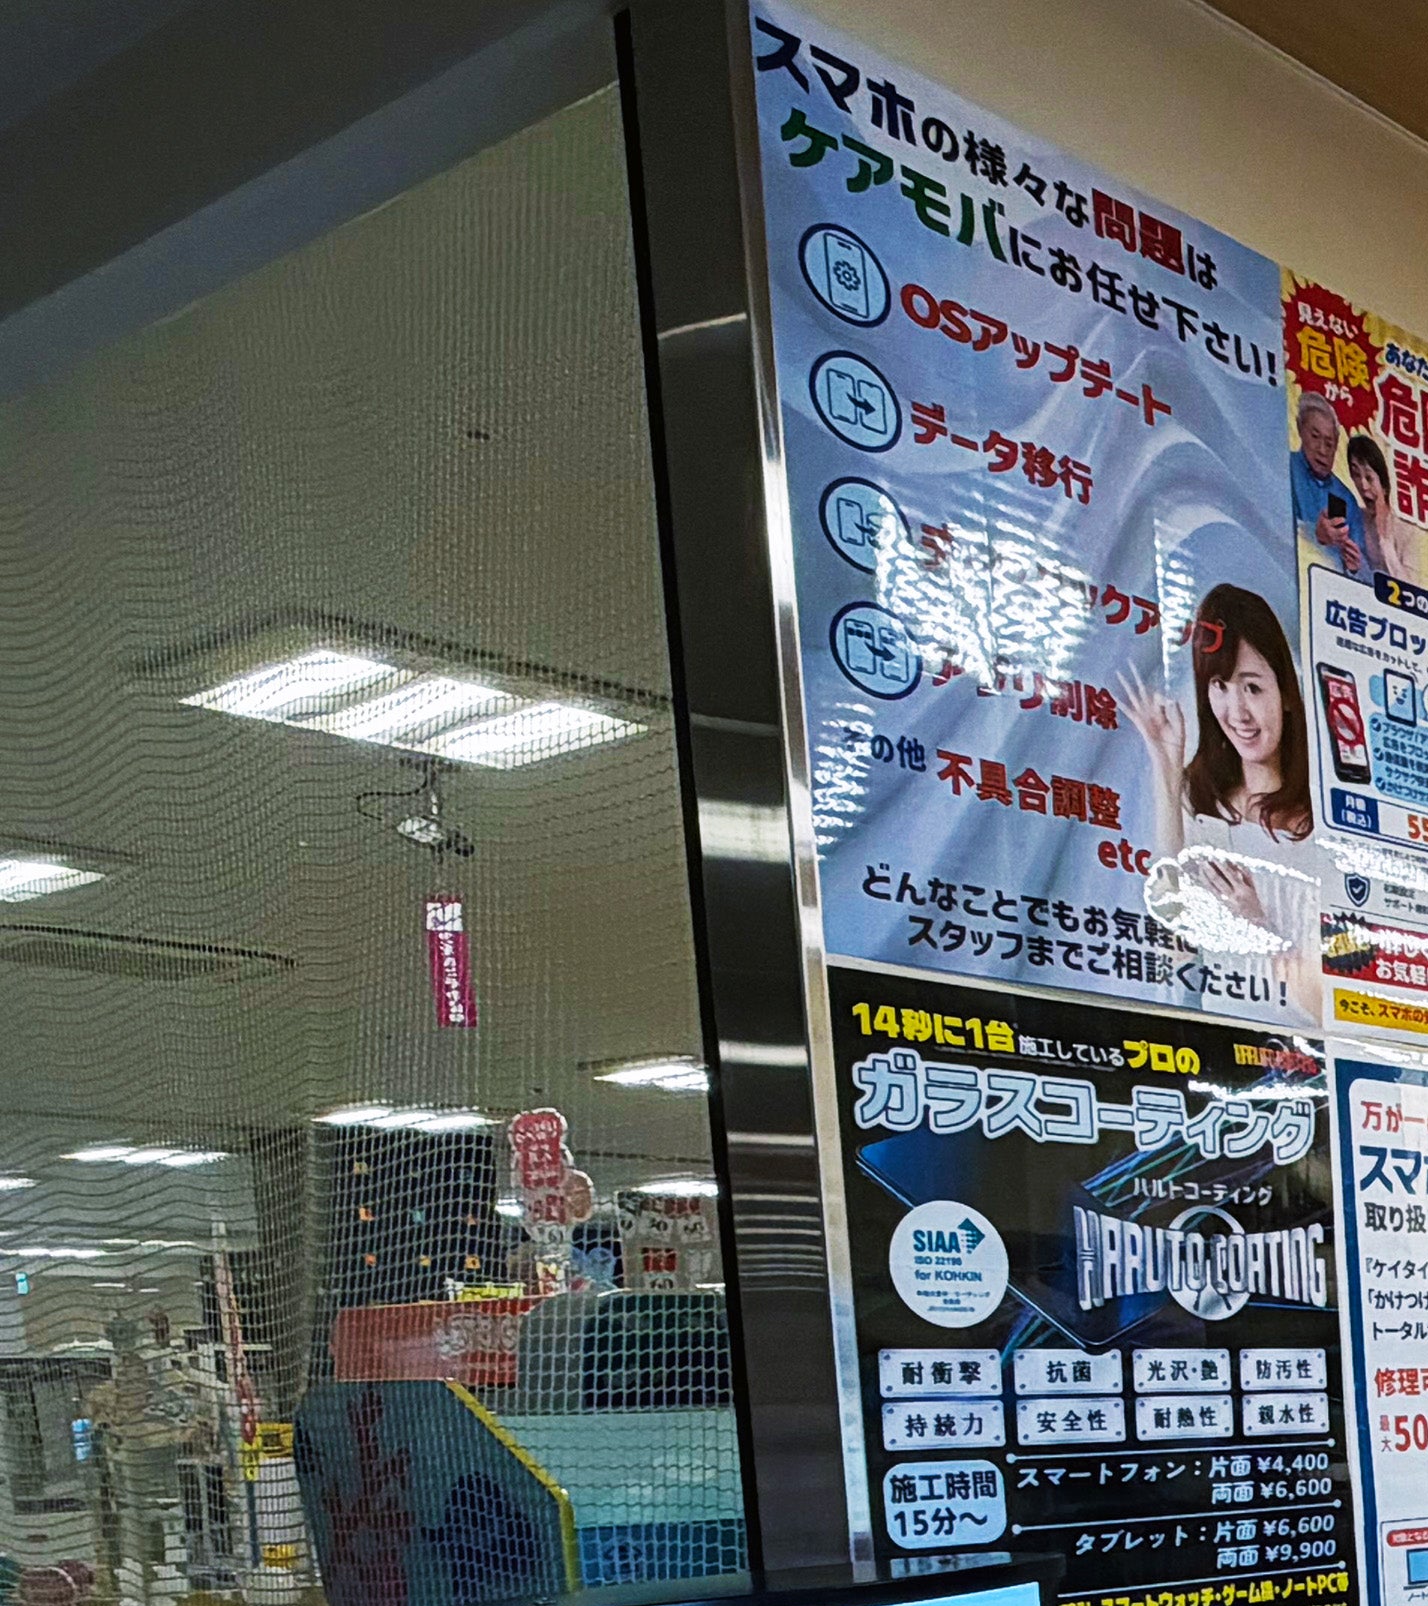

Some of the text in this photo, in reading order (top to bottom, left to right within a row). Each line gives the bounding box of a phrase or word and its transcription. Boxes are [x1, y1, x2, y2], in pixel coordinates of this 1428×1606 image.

[752, 15, 1219, 291] スマホの様々な問題は
[1298, 302, 1359, 339] 見えない
[900, 282, 1172, 427] OSアップデート
[1297, 326, 1371, 392] 危険
[1324, 381, 1354, 407] から
[909, 400, 1094, 505] データ移行
[937, 748, 1122, 831] 不具合調整
[852, 1001, 1200, 1074] 14秒に1台施工しているプロの
[854, 1048, 1315, 1165] ガラスコーティング
[1134, 1176, 1273, 1206] ハルトコーティング
[913, 1230, 961, 1253] SIAA
[915, 1270, 931, 1279] for
[901, 1362, 982, 1386] 耐衝撃
[1046, 1360, 1092, 1384] 抗菌
[1255, 1358, 1313, 1380] 防汚性
[904, 1404, 1314, 1437] 持続力 安全性 耐熱性 親水性
[1209, 1455, 1251, 1478] 片面
[1257, 1453, 1329, 1474] ¥4,400
[889, 1469, 998, 1502] 施工時間
[1211, 1477, 1332, 1504] 両面 ¥6,600
[1214, 1520, 1257, 1543] 片面
[1262, 1514, 1335, 1536] ¥6,600
[1216, 1540, 1336, 1569] 両面 ¥9,900
